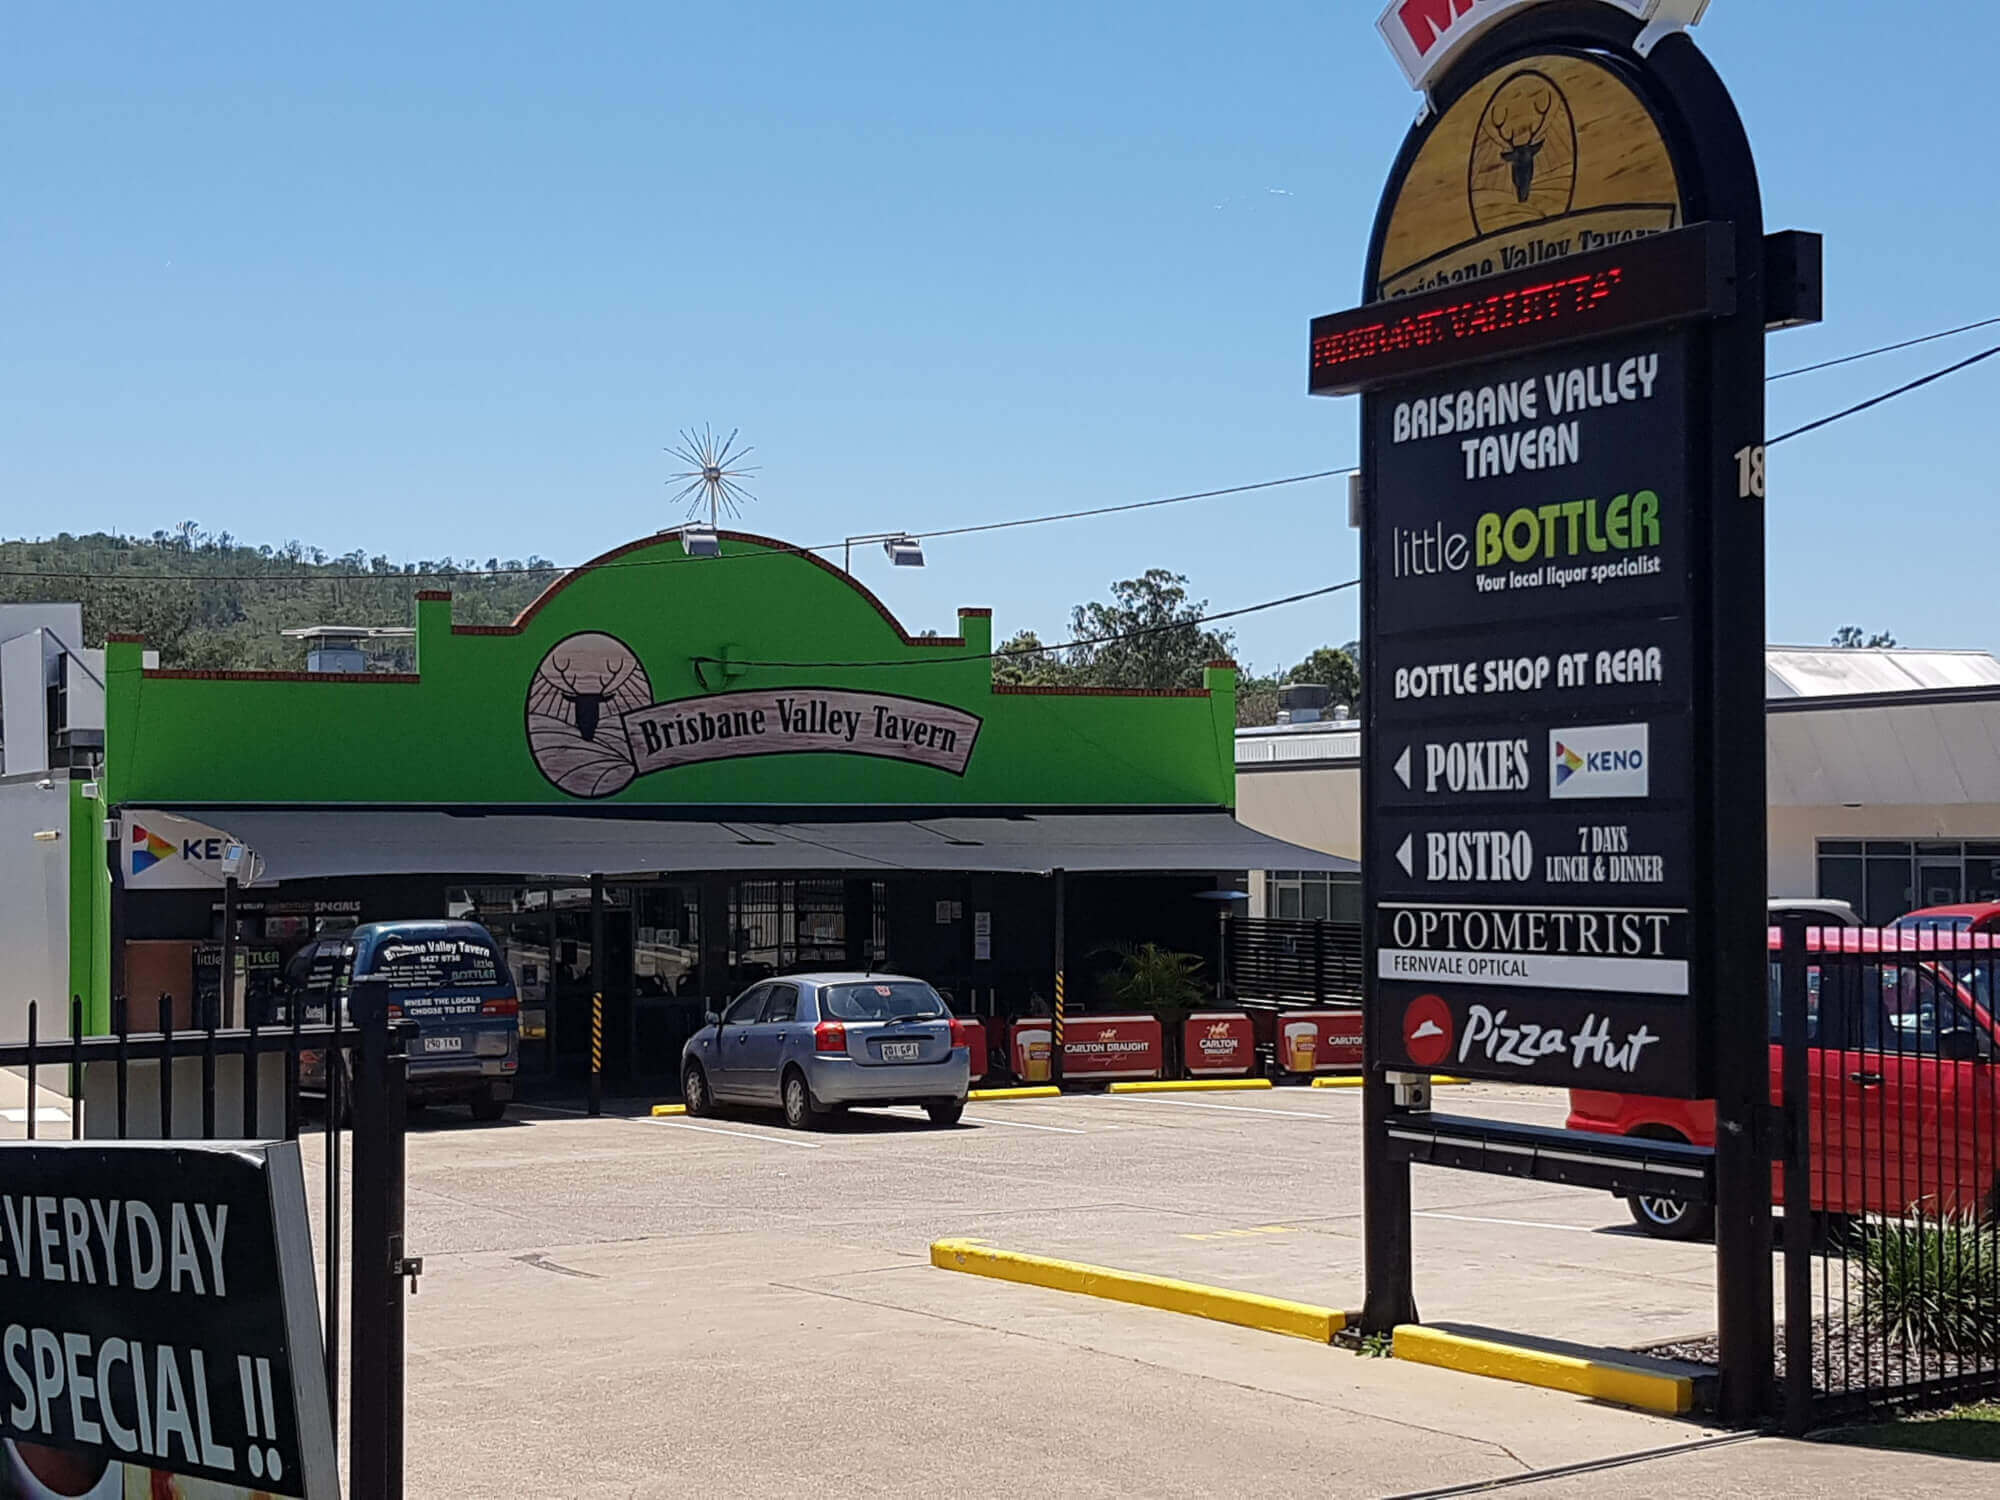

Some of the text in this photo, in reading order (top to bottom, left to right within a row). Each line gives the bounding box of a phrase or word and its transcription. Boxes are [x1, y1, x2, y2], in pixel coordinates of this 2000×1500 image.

[1393, 353, 1659, 443] BRISBANE VALLEY
[1461, 421, 1580, 480] TAVERN
[1394, 490, 1661, 578] little BOTTLER
[1476, 556, 1661, 593] Your local liquor specialist
[1395, 646, 1662, 699] BOTTLE SHOP AT REAR
[639, 698, 957, 756] Brisbane Valley Tavern
[1425, 739, 1529, 792] POKIES
[1586, 749, 1643, 773] KENO
[1426, 829, 1533, 881] BISTRO
[1578, 825, 1629, 853] 7 DAYS
[1546, 855, 1664, 883] LUNCH & DINNER
[427, 941, 457, 954] Valley
[458, 941, 490, 958] Tavern
[1393, 910, 1670, 956] OPTOMETRIST
[1394, 955, 1529, 978] FERNVALE OPTICAL
[1064, 1042, 1149, 1053] CARLTON DRAUGHT
[1199, 1039, 1238, 1048] CARLTON
[1458, 1004, 1660, 1073] Pizza Hut
[3, 1324, 236, 1472] SPECIAL
